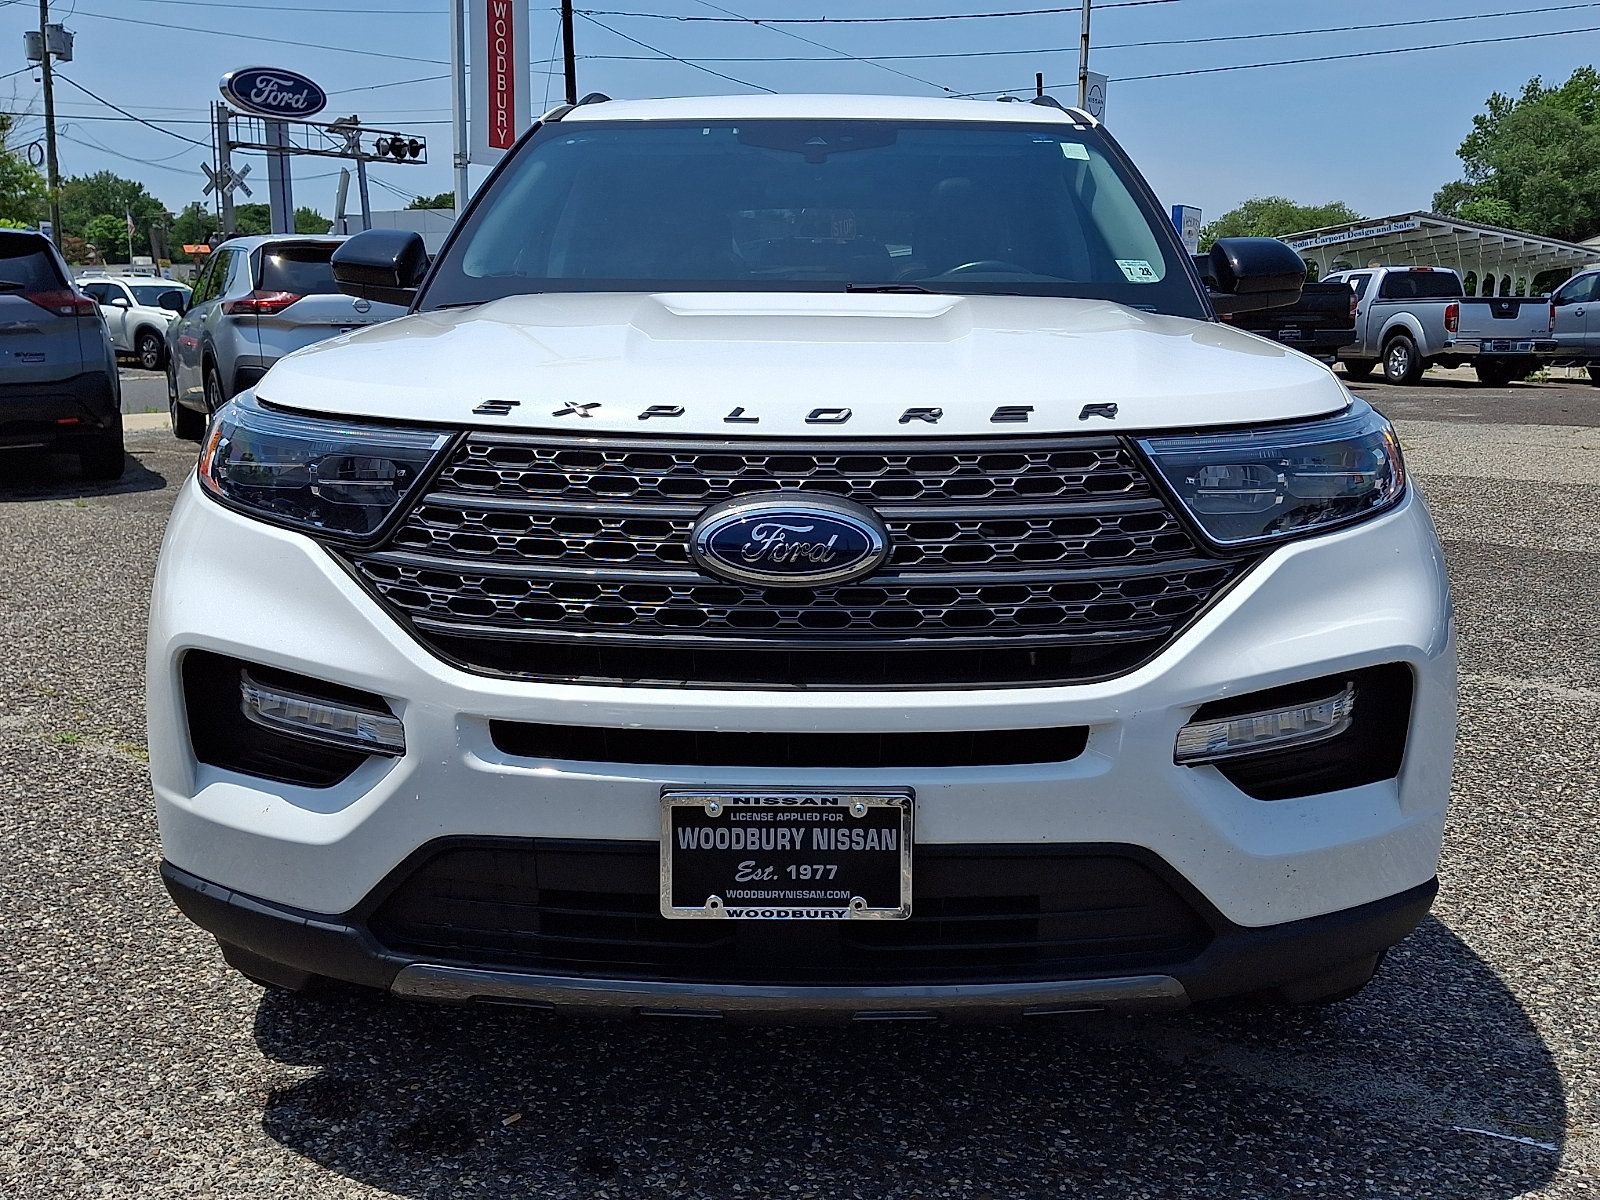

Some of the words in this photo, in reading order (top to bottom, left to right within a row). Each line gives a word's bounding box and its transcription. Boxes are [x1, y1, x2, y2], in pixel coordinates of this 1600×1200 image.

[493, 0, 507, 145] WOODBURY
[251, 75, 308, 108] Ford
[1292, 240, 1313, 249] Solar
[1314, 234, 1345, 245] Carport
[1347, 229, 1375, 239] Design
[1375, 225, 1392, 234] and
[1393, 222, 1416, 230] Sales
[1125, 267, 1133, 276] 7
[1138, 267, 1153, 276] 28
[472, 399, 1119, 425] EXPLORER
[741, 522, 839, 563] Ford
[732, 797, 839, 806] NISSAN
[730, 812, 774, 821] LICENSE
[776, 812, 821, 821] APPLIED
[822, 813, 844, 822] FOR
[677, 826, 806, 851] WOODBURY
[812, 828, 897, 851] NISSAN
[734, 860, 779, 882] Est.
[786, 864, 838, 880] 1977
[725, 889, 851, 899] WOODBURYNISSAN.COM
[725, 909, 847, 919] WOODBURY
